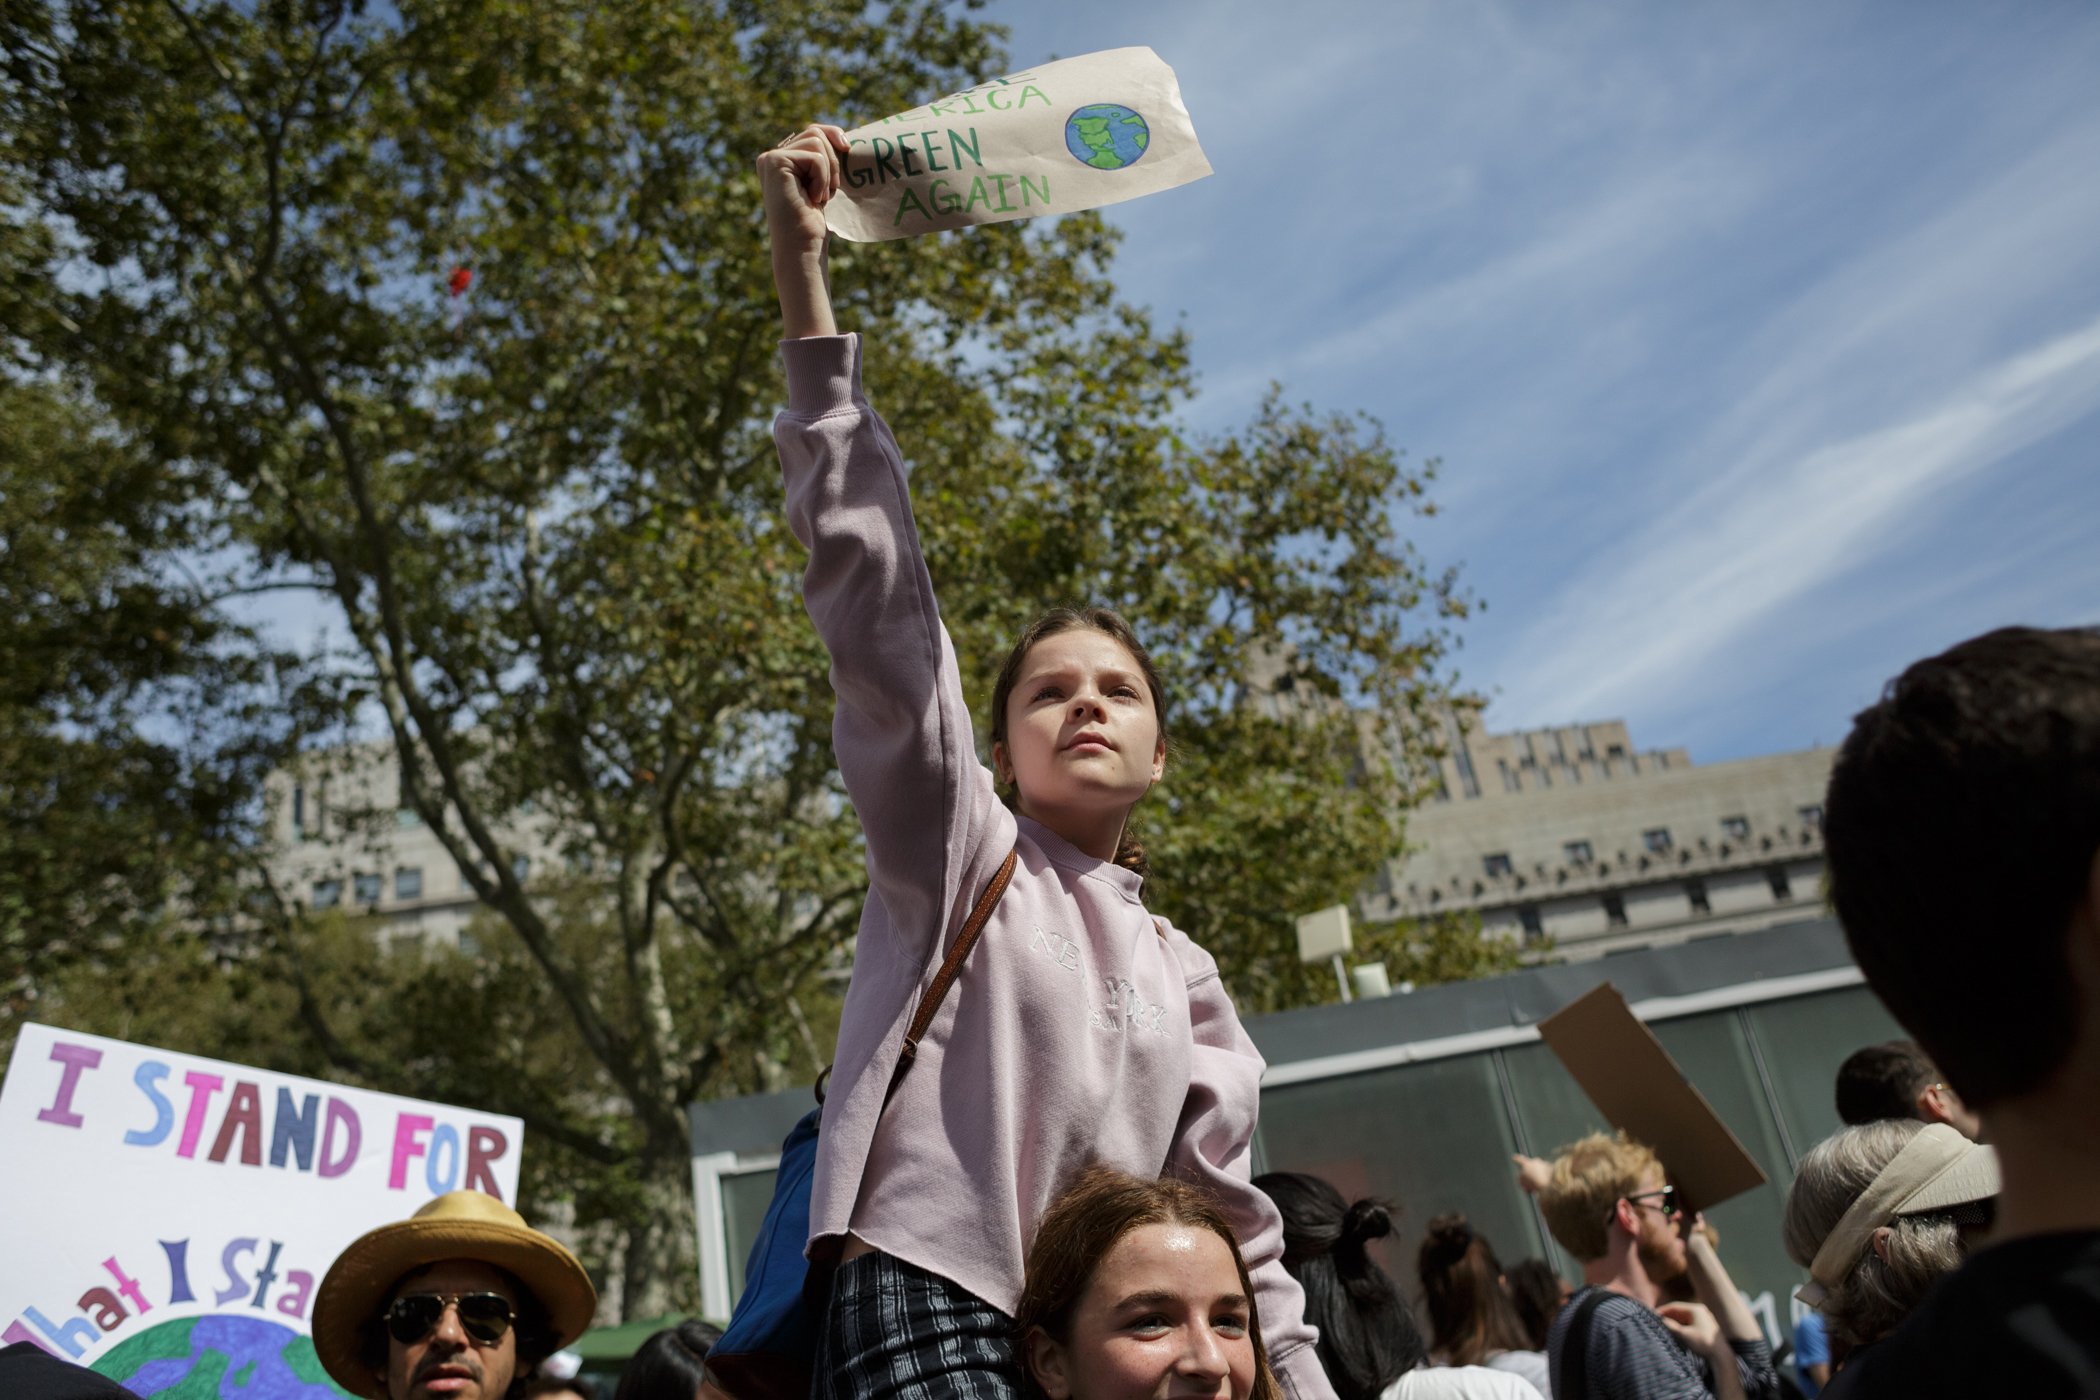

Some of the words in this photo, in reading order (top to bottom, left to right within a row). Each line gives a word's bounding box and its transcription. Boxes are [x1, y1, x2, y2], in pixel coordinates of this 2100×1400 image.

[882, 85, 1052, 125] ERICA
[842, 127, 983, 189] GREEN
[893, 174, 1052, 226] AGAIN
[37, 1042, 103, 1129] I
[124, 1061, 362, 1178] STAND
[388, 1112, 508, 1203] FOR
[158, 1237, 198, 1305] I
[213, 1237, 315, 1320] Sta
